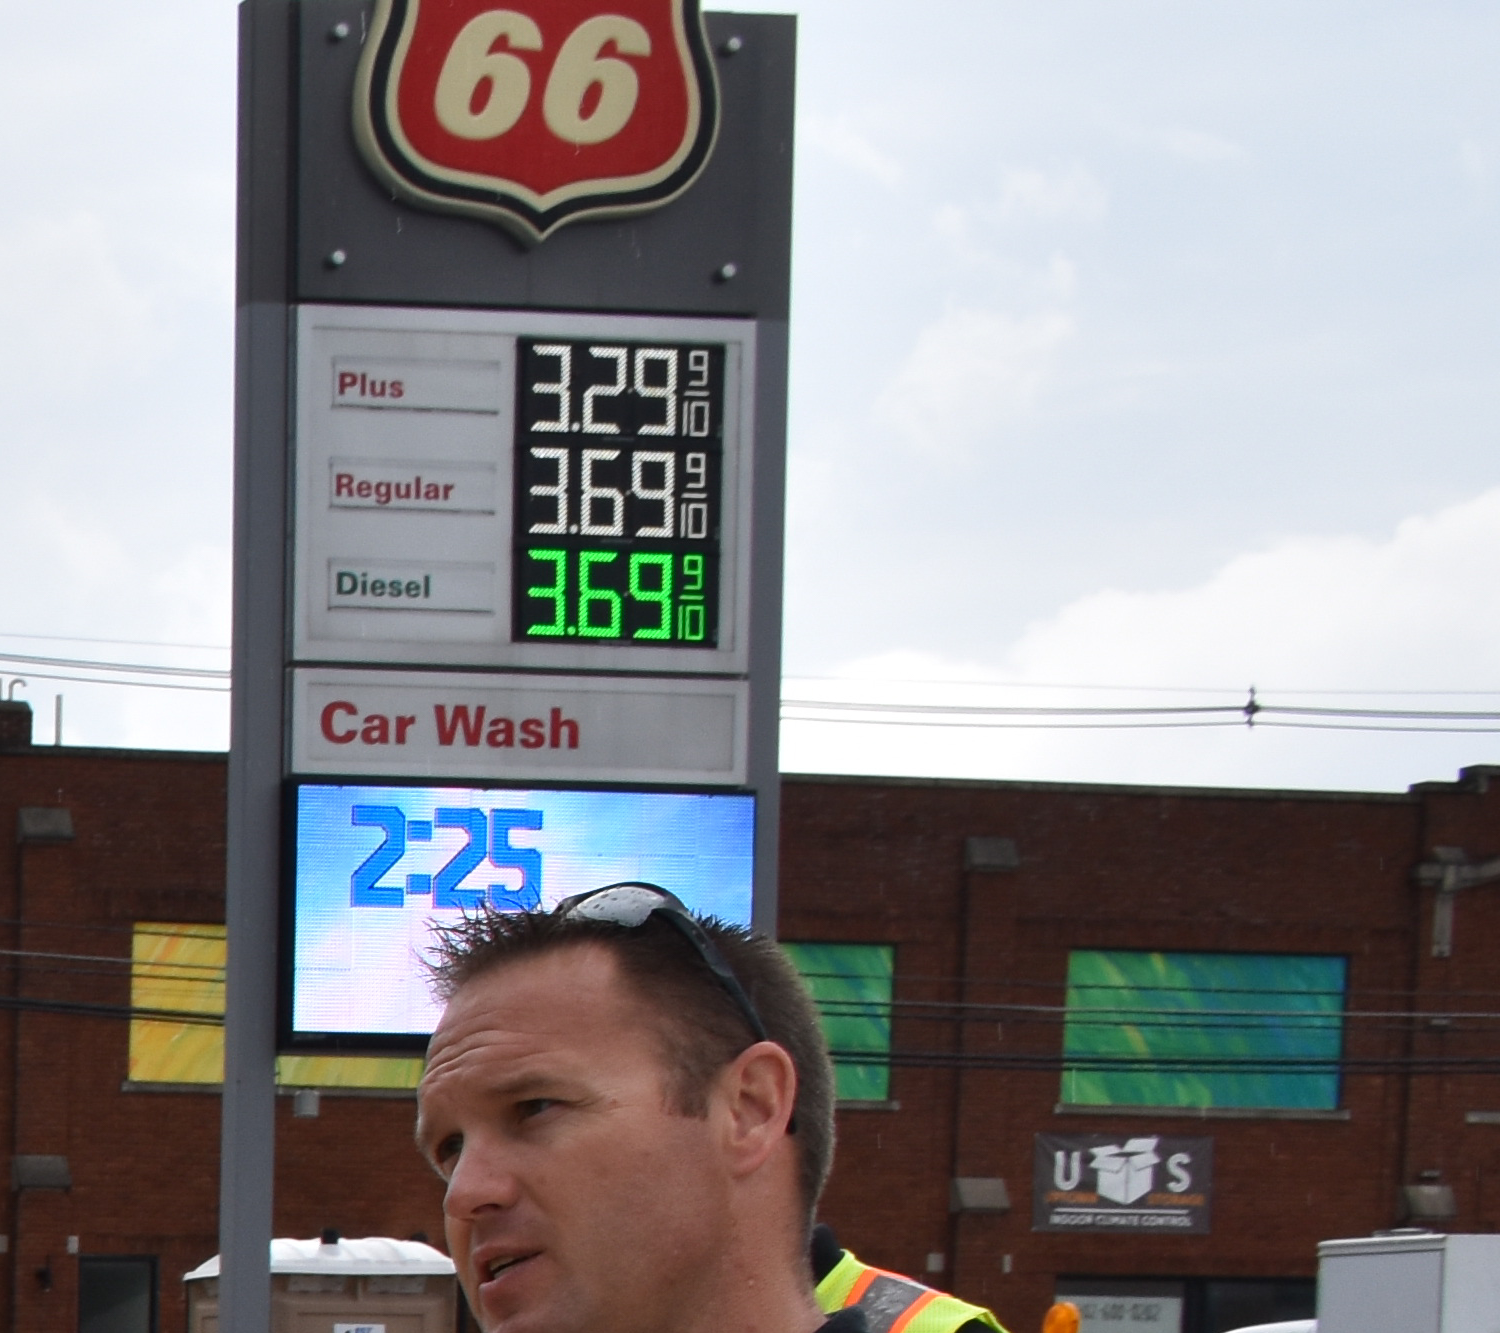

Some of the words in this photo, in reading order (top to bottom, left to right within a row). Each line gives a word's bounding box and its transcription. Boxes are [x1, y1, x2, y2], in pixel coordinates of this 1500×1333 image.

[434, 9, 652, 145] 66
[338, 371, 405, 398] Plus
[530, 344, 678, 436] 3.29
[334, 473, 455, 505] Regular
[528, 447, 677, 539] 3.69
[335, 571, 432, 599] Diesel
[526, 549, 674, 641] 3.69
[319, 700, 416, 746] Car
[433, 703, 581, 750] Wash
[349, 804, 545, 909] 2:25
